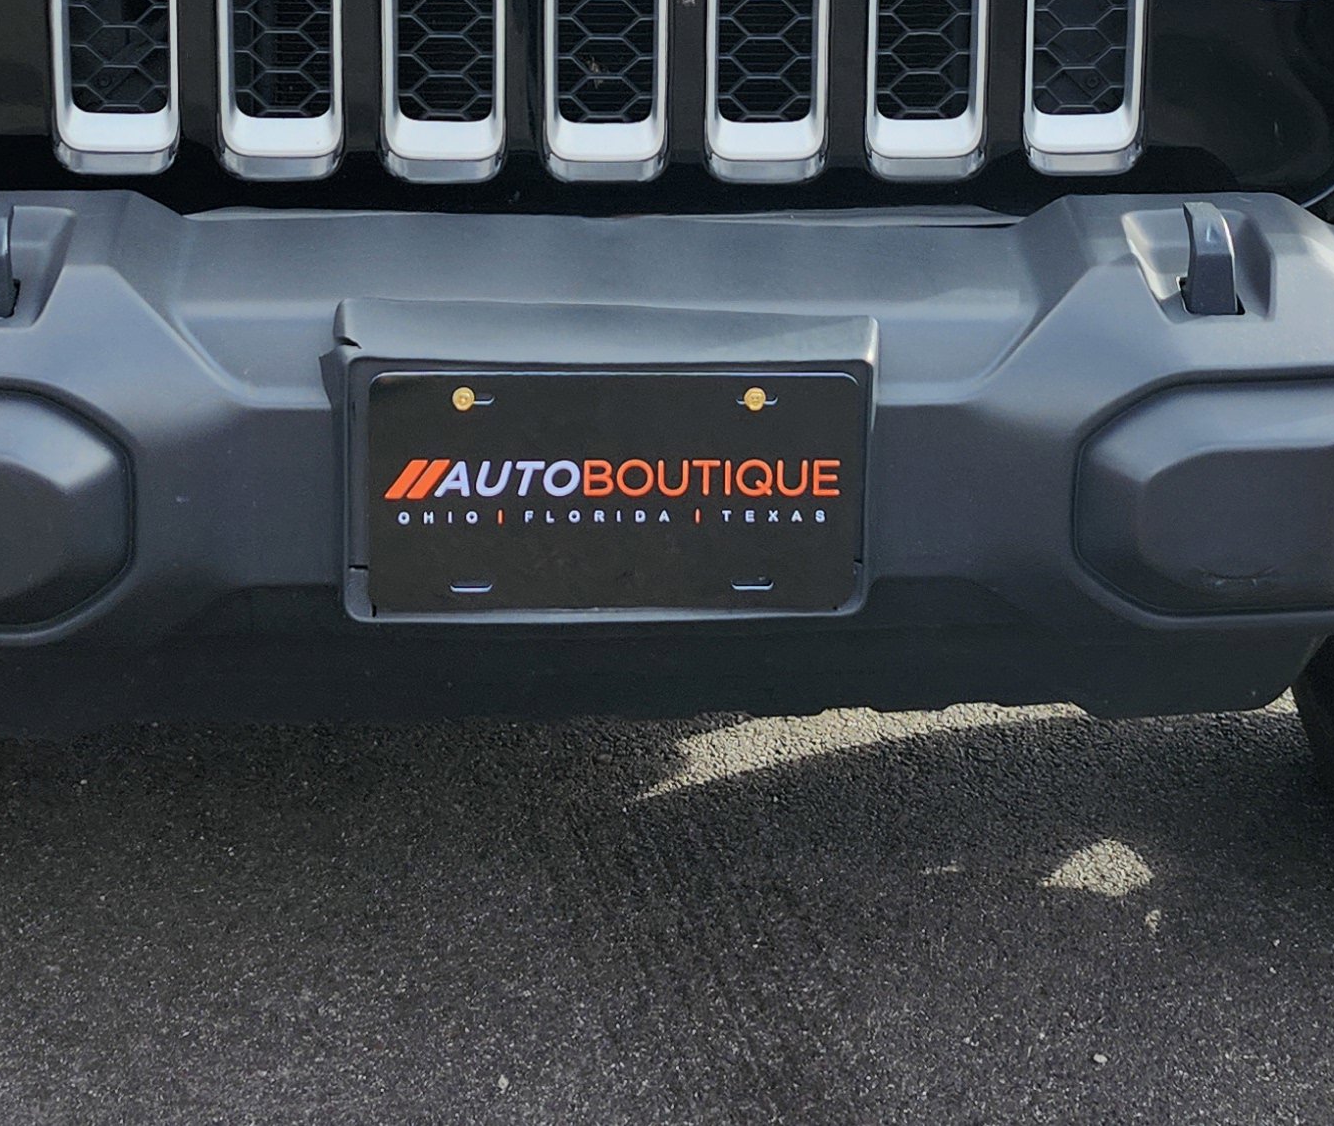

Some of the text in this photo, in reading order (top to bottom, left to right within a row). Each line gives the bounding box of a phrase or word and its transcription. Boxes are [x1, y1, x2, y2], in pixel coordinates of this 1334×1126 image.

[434, 459, 841, 498] AUTOBOUTIQUE
[397, 509, 827, 525] OHIO FLORIDA TEXAS
